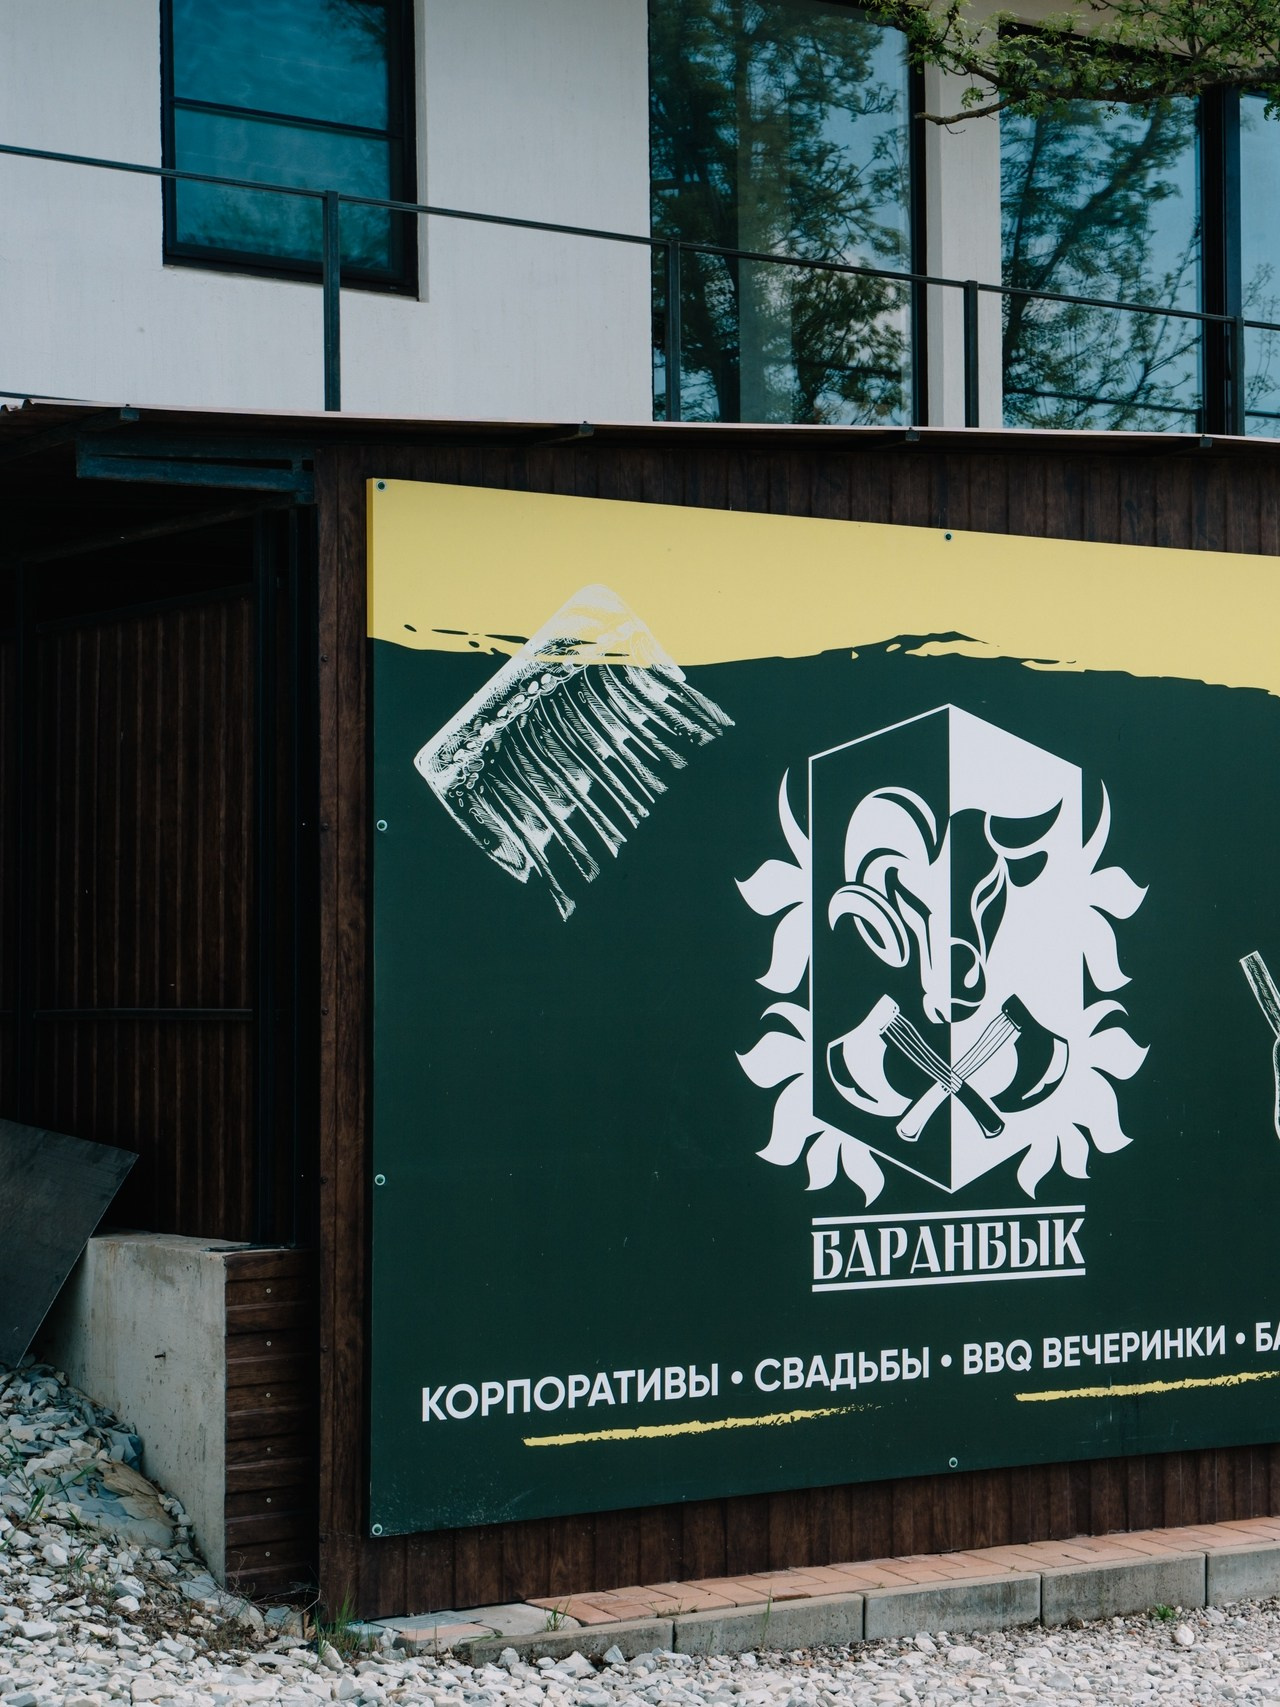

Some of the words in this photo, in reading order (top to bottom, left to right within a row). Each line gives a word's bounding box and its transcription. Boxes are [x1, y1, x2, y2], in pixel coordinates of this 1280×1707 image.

[810, 1217, 1086, 1280] БАРАНБЫК
[421, 1362, 719, 1423] КОРПОРАТИВЫ
[754, 1346, 930, 1392] СВАДЬБЫ
[963, 1339, 1033, 1375] BBQ
[1042, 1324, 1226, 1369] ВЕЧЕРИНКИ
